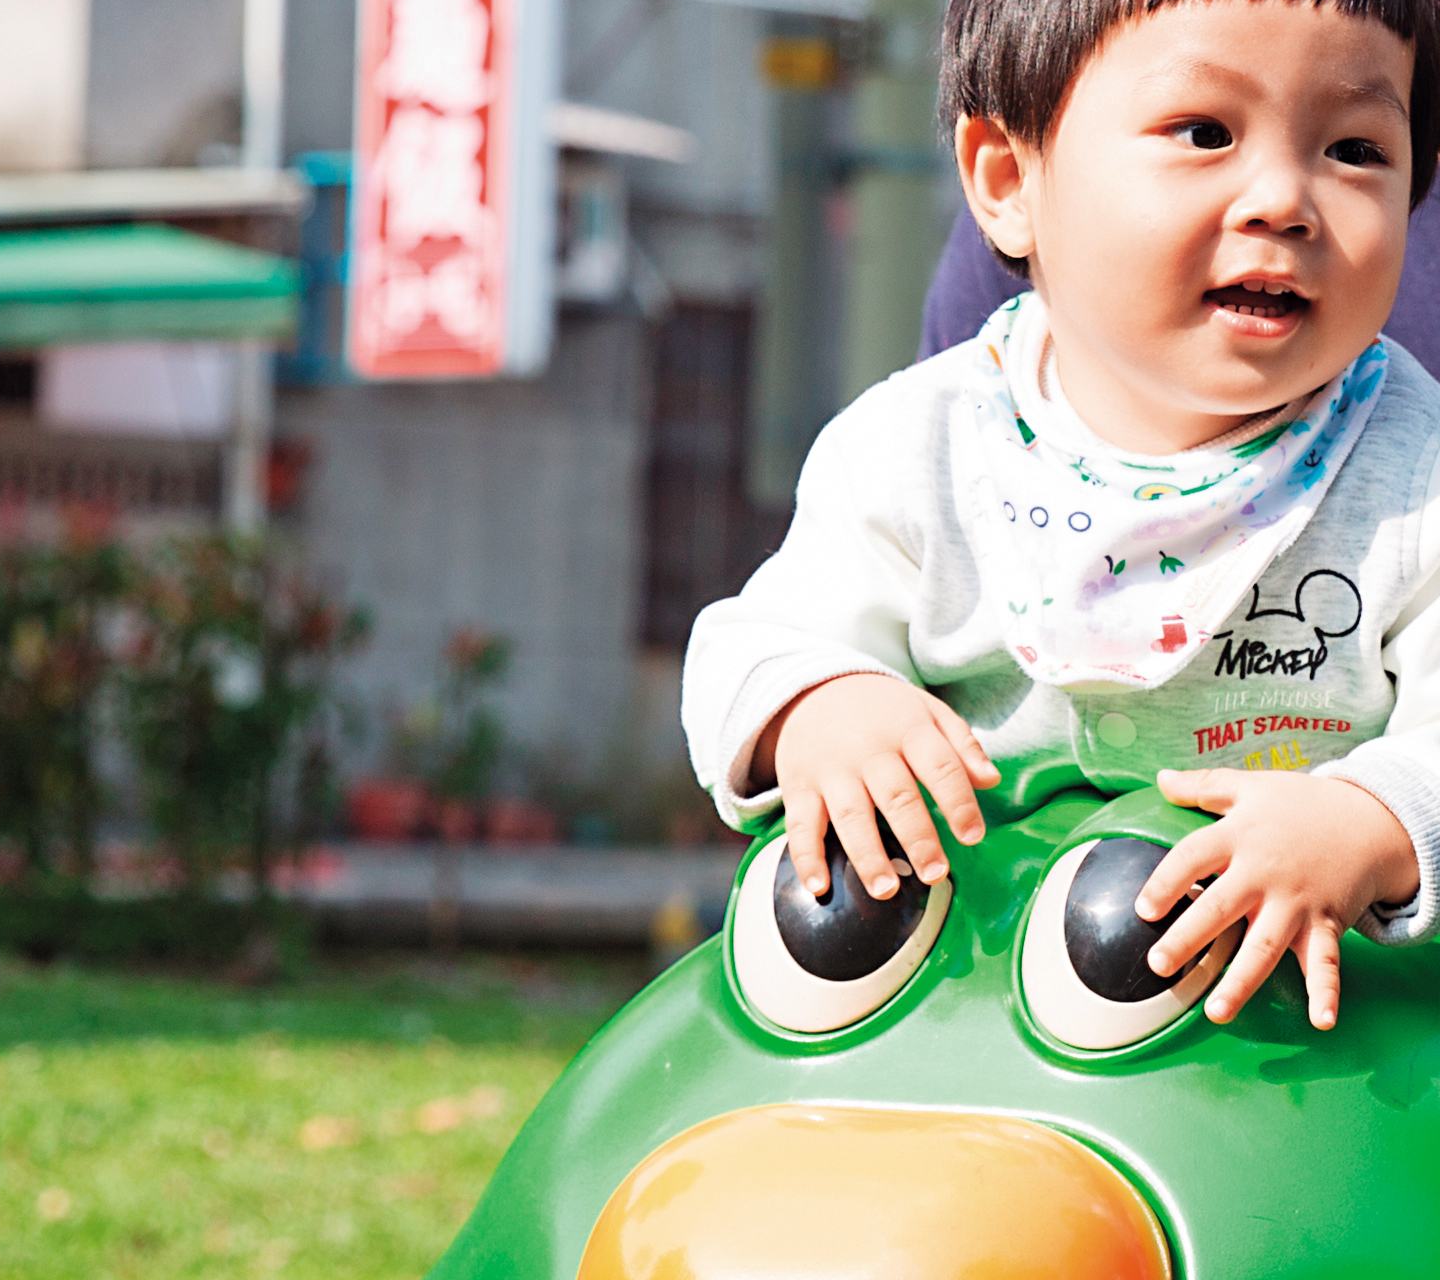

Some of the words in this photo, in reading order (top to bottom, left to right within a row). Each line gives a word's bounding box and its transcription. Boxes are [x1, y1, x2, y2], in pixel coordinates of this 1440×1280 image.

[1213, 690, 1250, 713] THE
[1260, 689, 1336, 709] MOUSE
[1193, 718, 1248, 754] THAT
[1253, 715, 1352, 735] STARTED
[1245, 751, 1264, 770] IT
[1269, 740, 1310, 770] ALL
